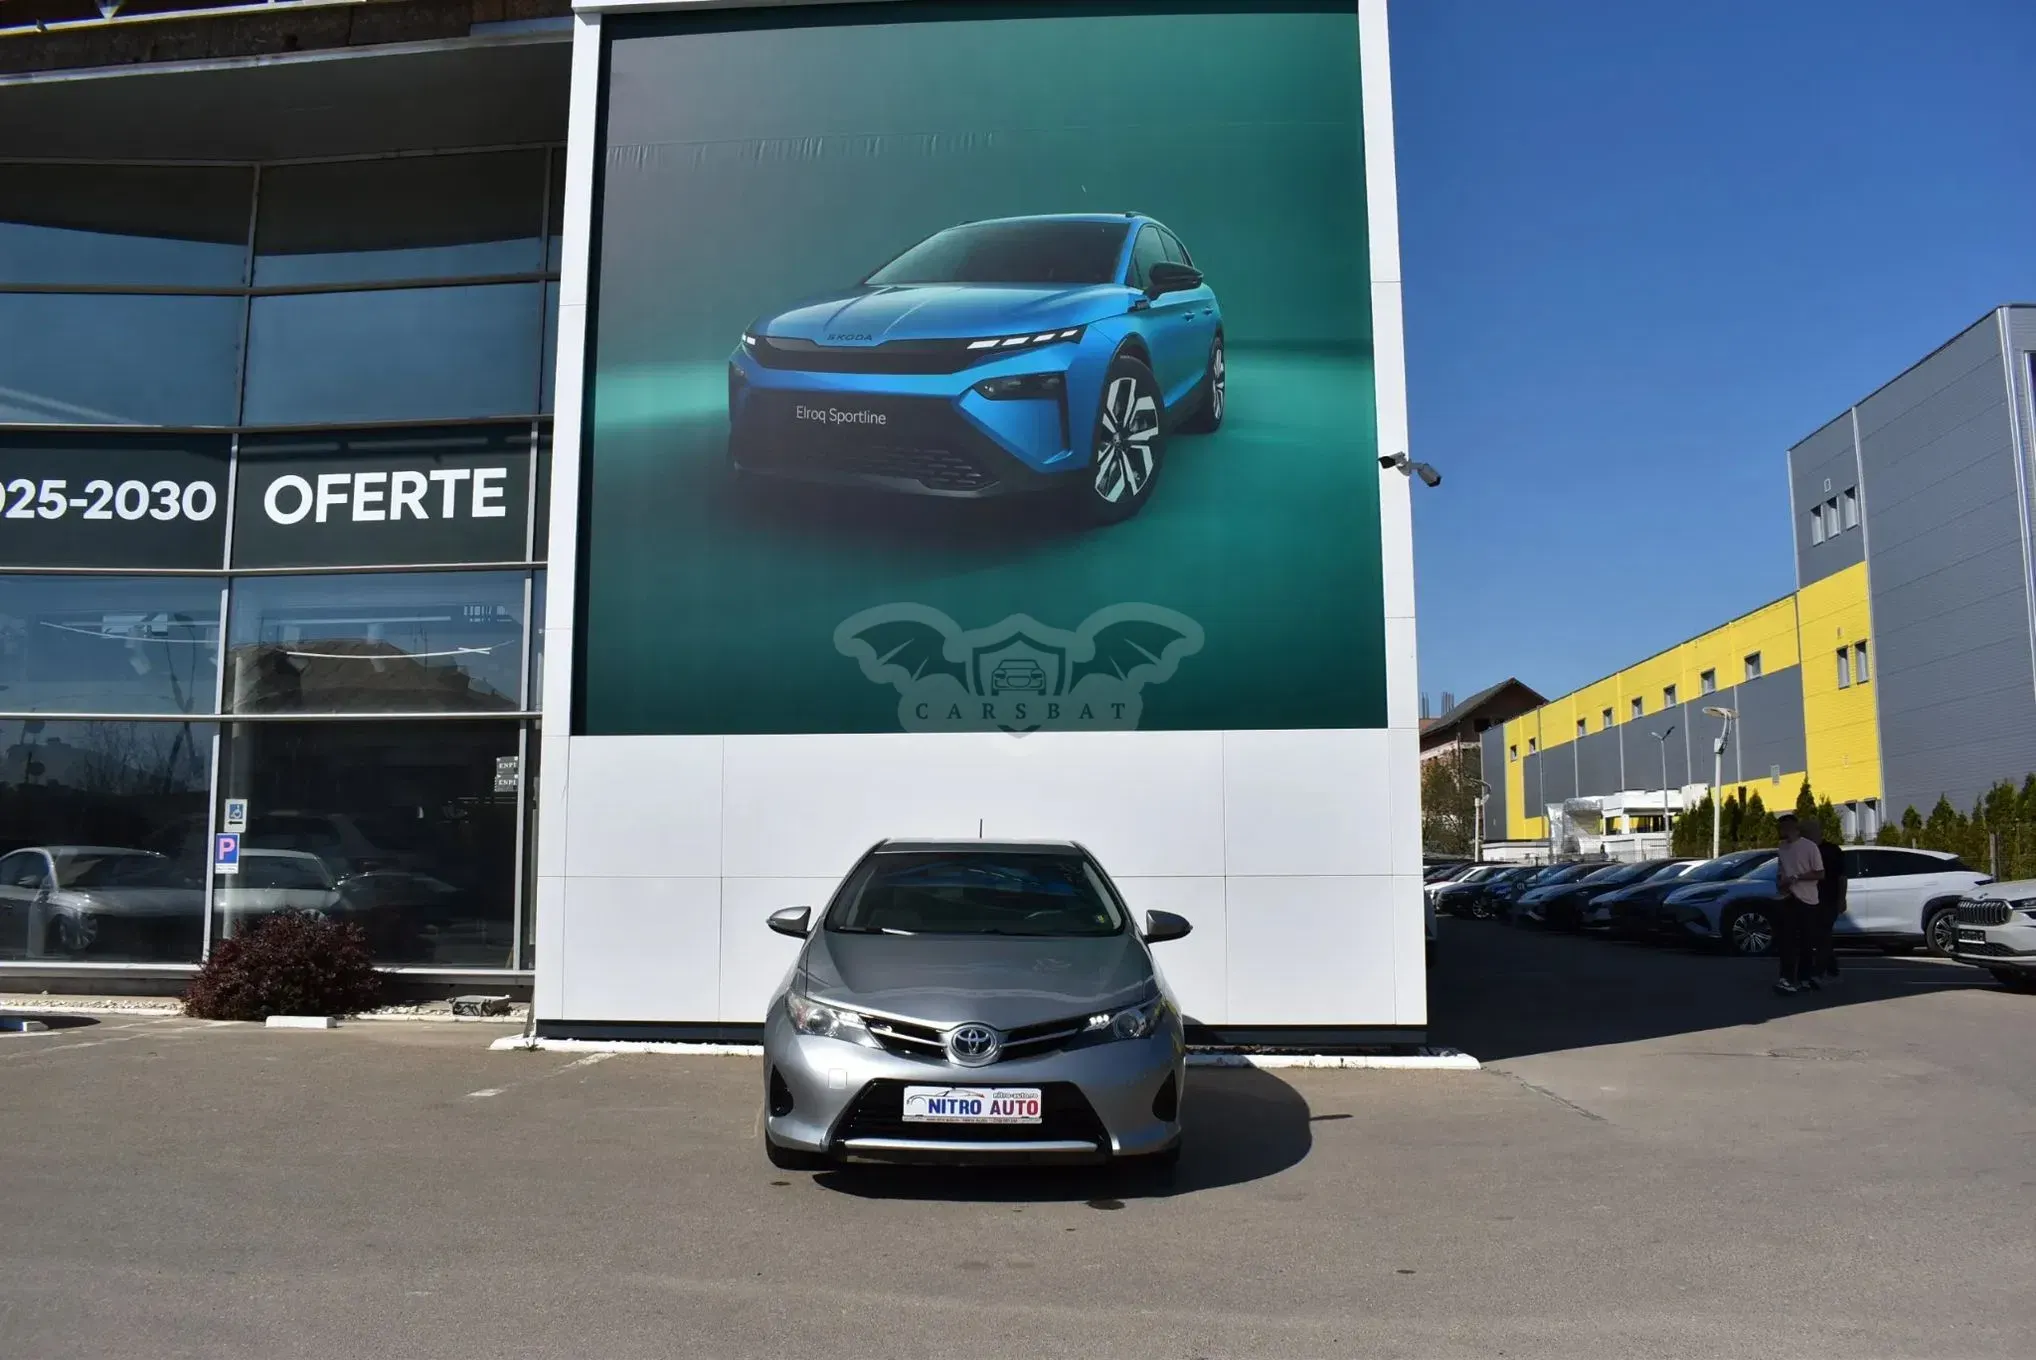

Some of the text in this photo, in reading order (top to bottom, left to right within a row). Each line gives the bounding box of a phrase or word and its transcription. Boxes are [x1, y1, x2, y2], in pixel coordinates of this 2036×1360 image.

[796, 405, 887, 425] Elroq Sportline
[0, 479, 217, 520] 25-2030
[264, 467, 507, 525] OFERTE
[219, 838, 236, 861] P
[928, 1098, 1039, 1116] NITRO AUTO
